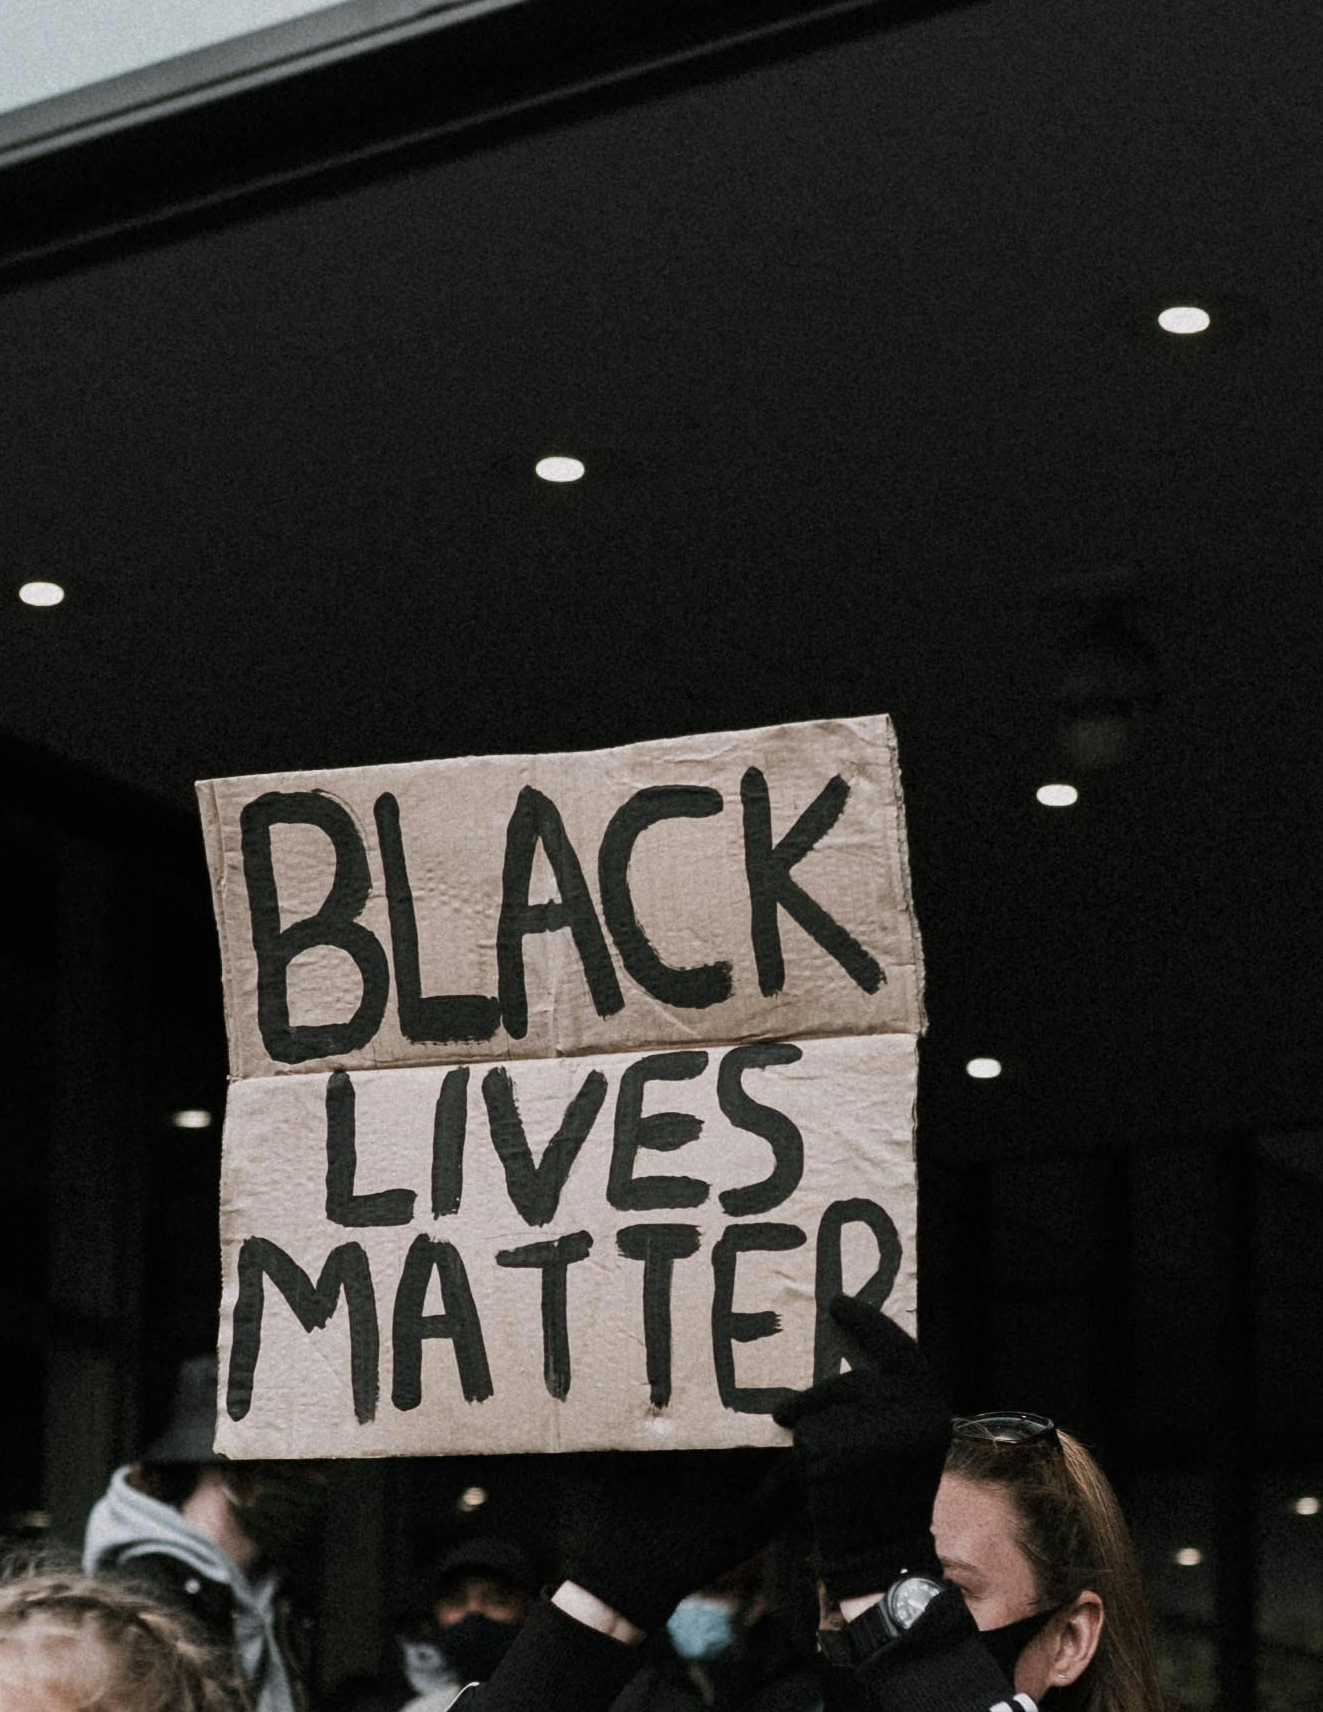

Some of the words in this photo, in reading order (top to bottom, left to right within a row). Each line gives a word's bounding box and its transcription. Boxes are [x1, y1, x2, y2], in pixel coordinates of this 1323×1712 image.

[239, 765, 888, 1065] BLACK
[325, 1042, 805, 1227] LIVES
[226, 1197, 904, 1425] MATTER
